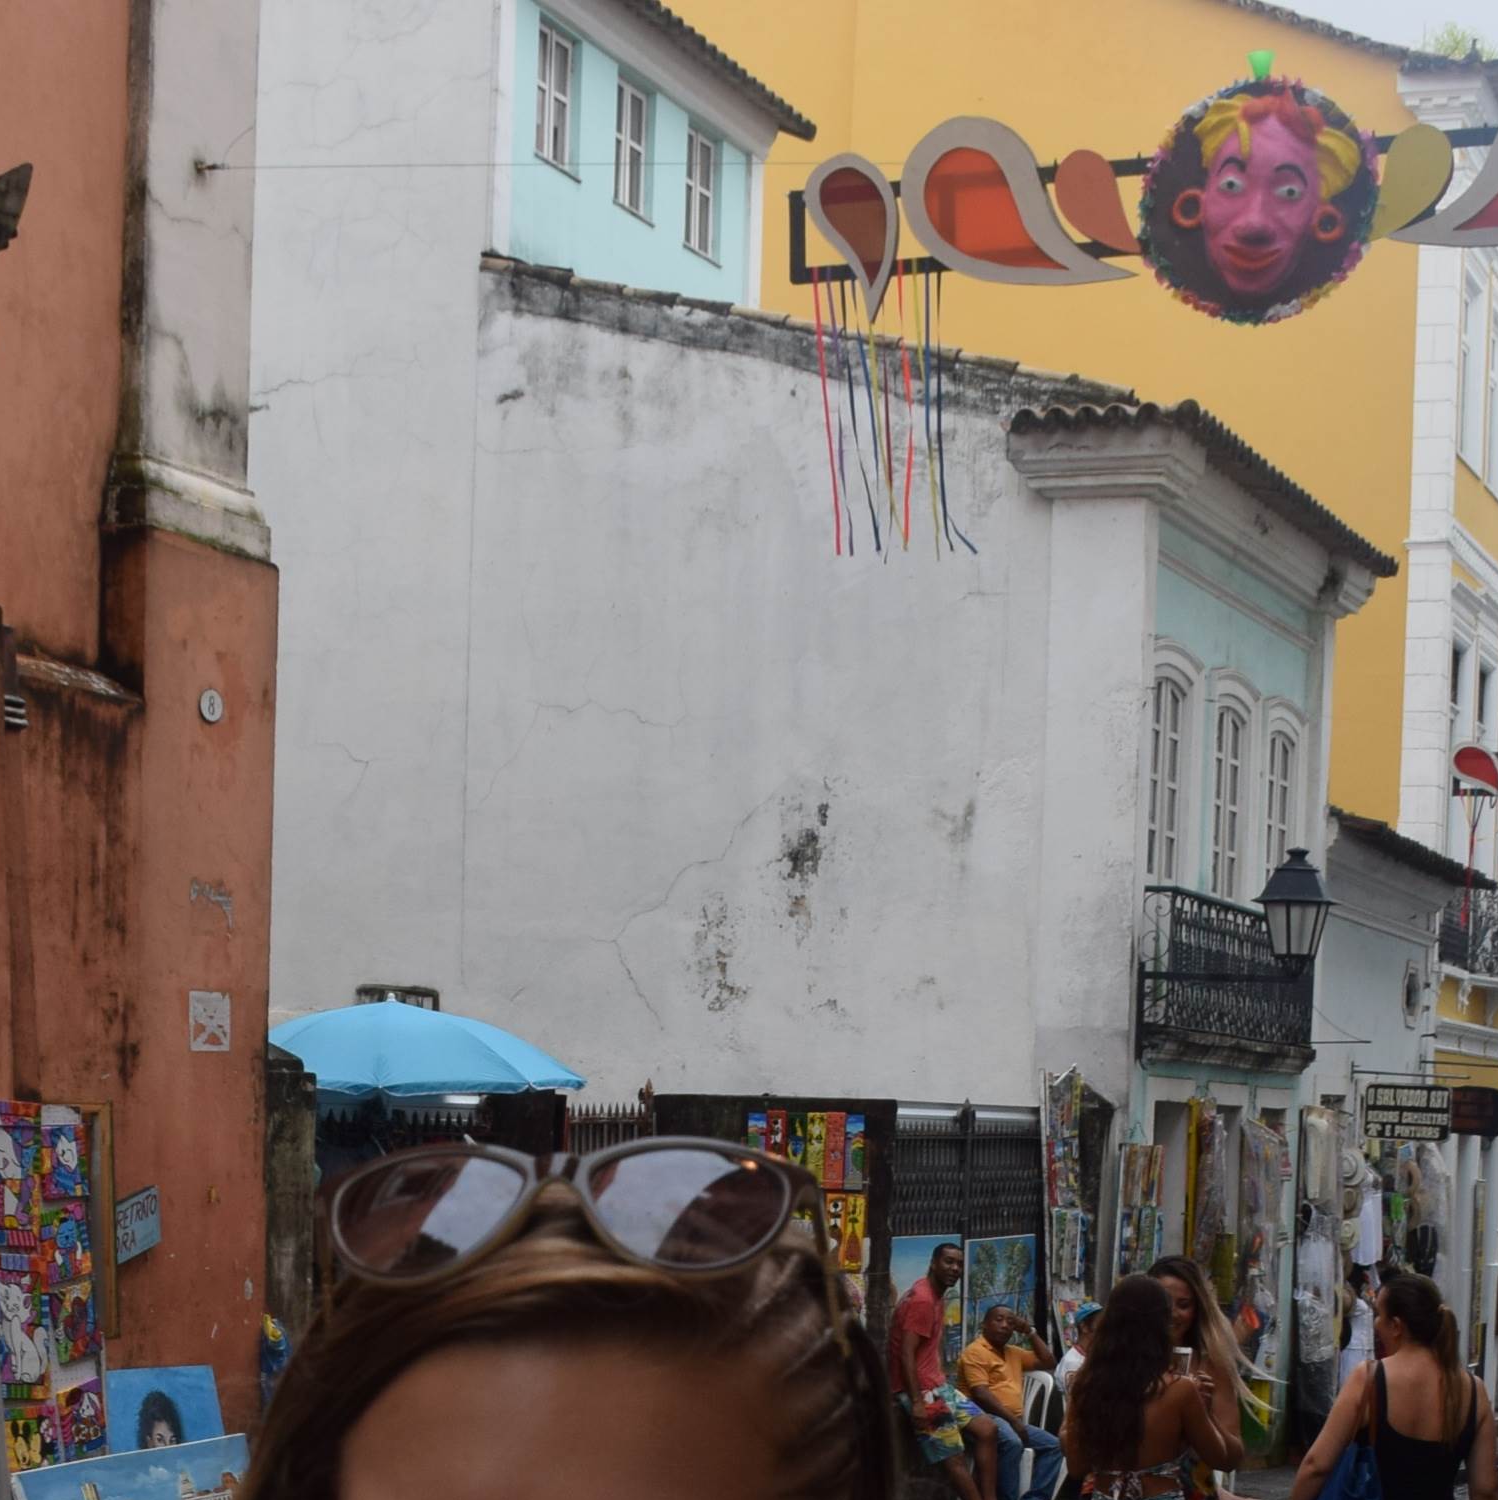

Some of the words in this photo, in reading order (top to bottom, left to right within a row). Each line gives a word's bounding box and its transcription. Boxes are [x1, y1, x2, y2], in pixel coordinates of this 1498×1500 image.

[207, 695, 215, 716] 8
[1377, 1089, 1428, 1107] SALVADOR
[117, 1194, 157, 1229] RETRATO
